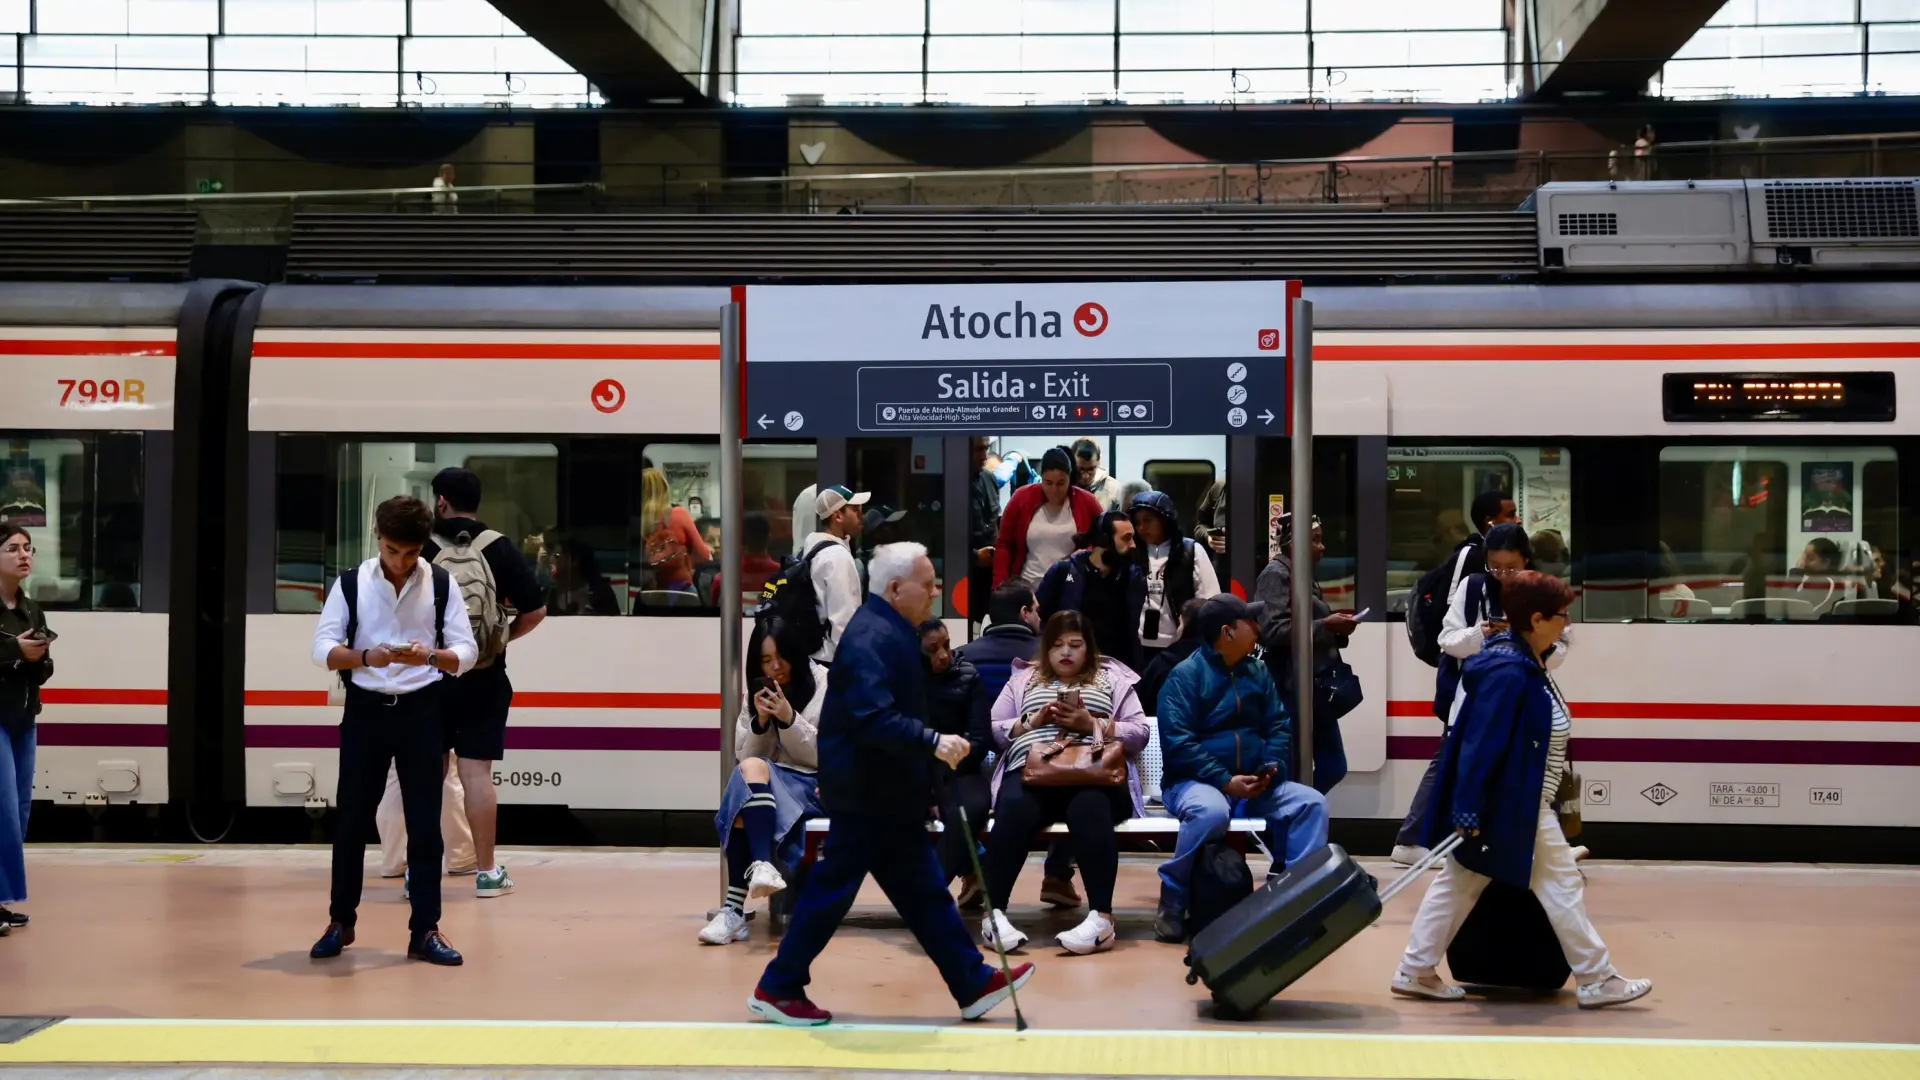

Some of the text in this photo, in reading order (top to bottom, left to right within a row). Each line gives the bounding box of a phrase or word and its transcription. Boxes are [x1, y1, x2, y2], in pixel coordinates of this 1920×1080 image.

[922, 301, 1061, 339] Atocha
[938, 372, 1025, 399] Salida
[1044, 371, 1090, 398] Exit
[57, 379, 145, 406] 799R
[898, 406, 920, 414] Puerta
[932, 405, 990, 413] Atocha-Almudena
[1048, 405, 1067, 420] T4
[962, 413, 981, 422] Speed
[492, 771, 562, 787] 5-099-0
[1711, 784, 1734, 793] TARA
[1745, 785, 1768, 794] 43.00
[1753, 797, 1764, 805] 63
[1813, 791, 1839, 803] 17,40
